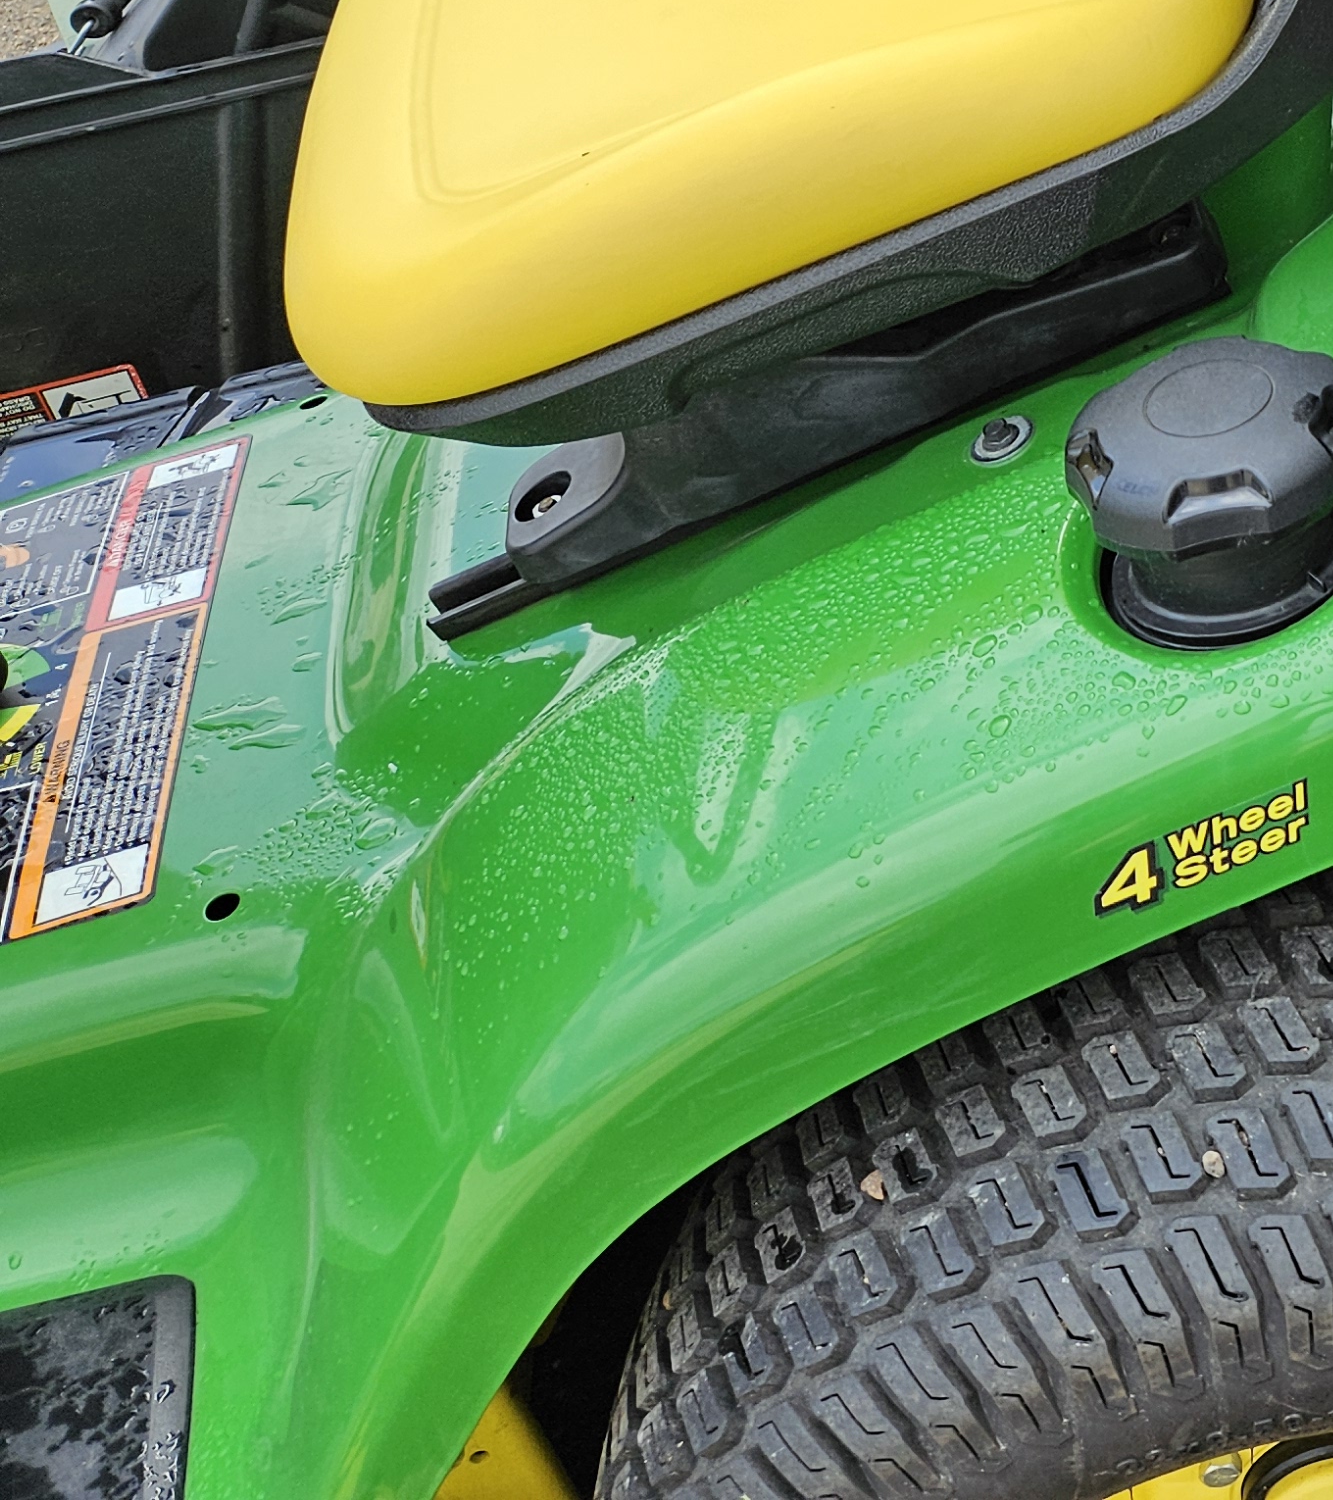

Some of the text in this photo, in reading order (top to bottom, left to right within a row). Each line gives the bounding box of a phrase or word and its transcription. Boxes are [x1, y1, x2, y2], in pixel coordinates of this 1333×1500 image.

[29, 741, 47, 775] LOWER
[45, 739, 71, 794] WARNING
[1101, 781, 1306, 908] 4 Wheel
[1174, 816, 1307, 888] Steer
